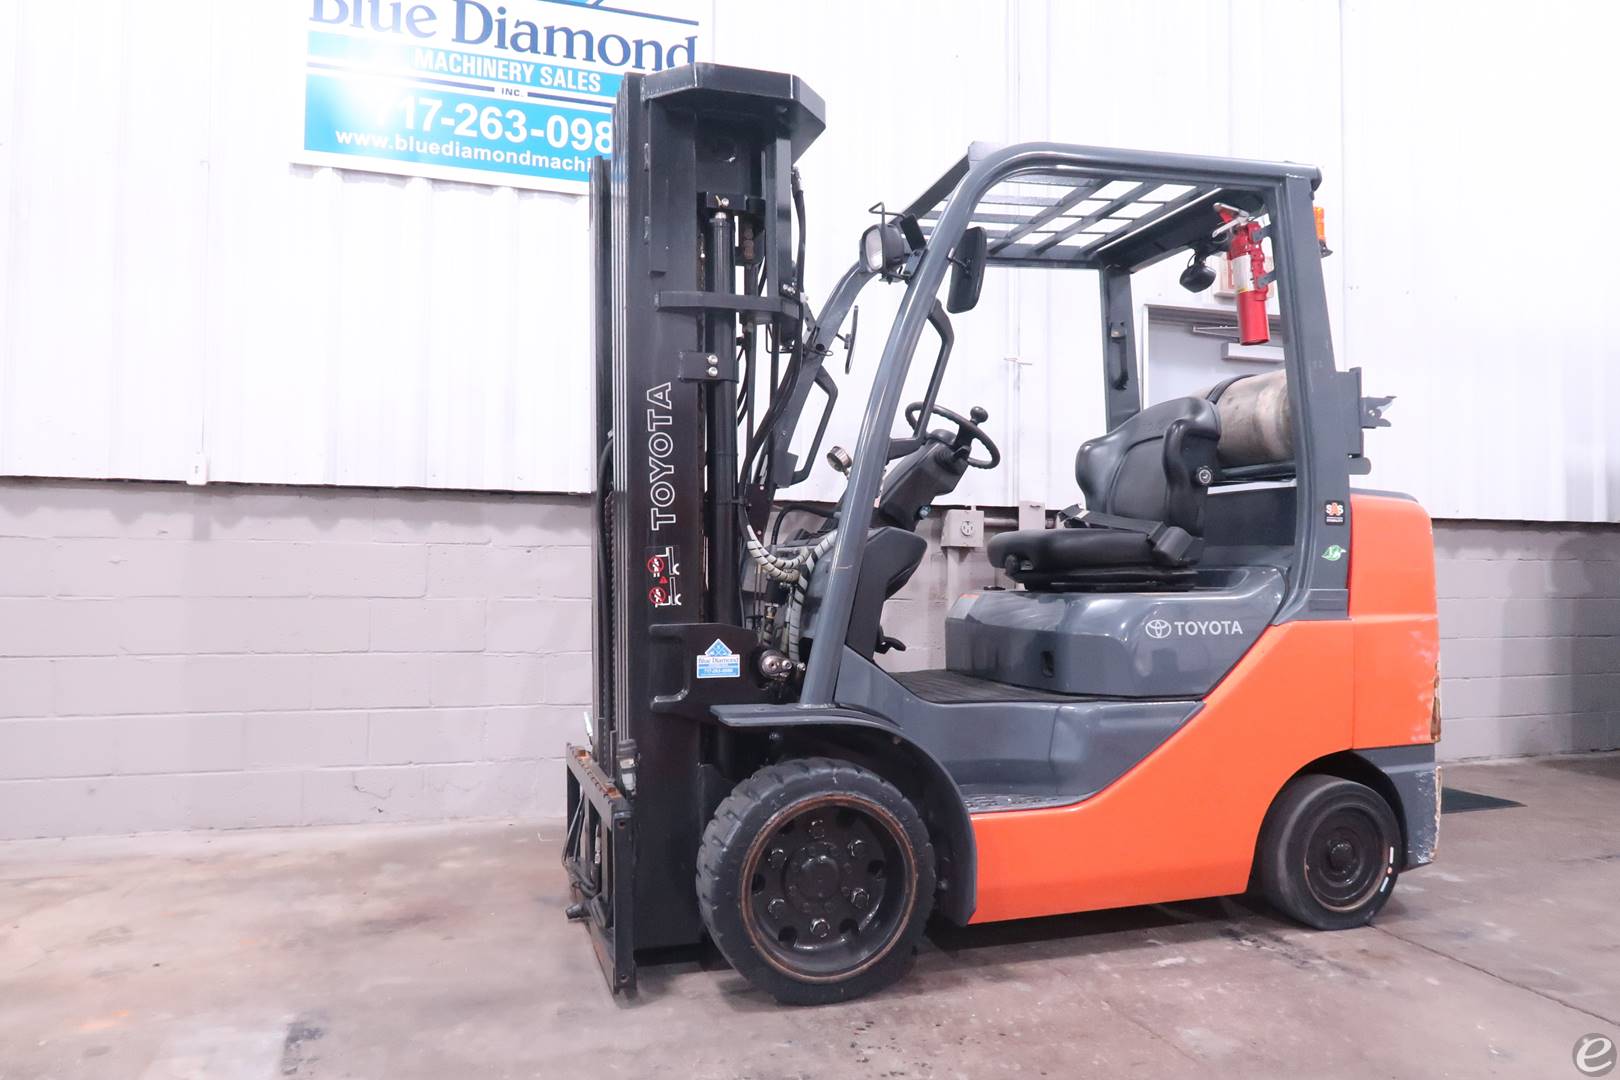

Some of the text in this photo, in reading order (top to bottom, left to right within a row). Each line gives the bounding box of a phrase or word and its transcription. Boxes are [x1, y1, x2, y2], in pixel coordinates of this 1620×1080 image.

[308, 0, 698, 71] Blue Diamond
[414, 48, 601, 92] MACHINERY SALES
[501, 87, 524, 97] INC.
[647, 382, 676, 531] TOYOTA
[1174, 621, 1243, 636] TOYOTA
